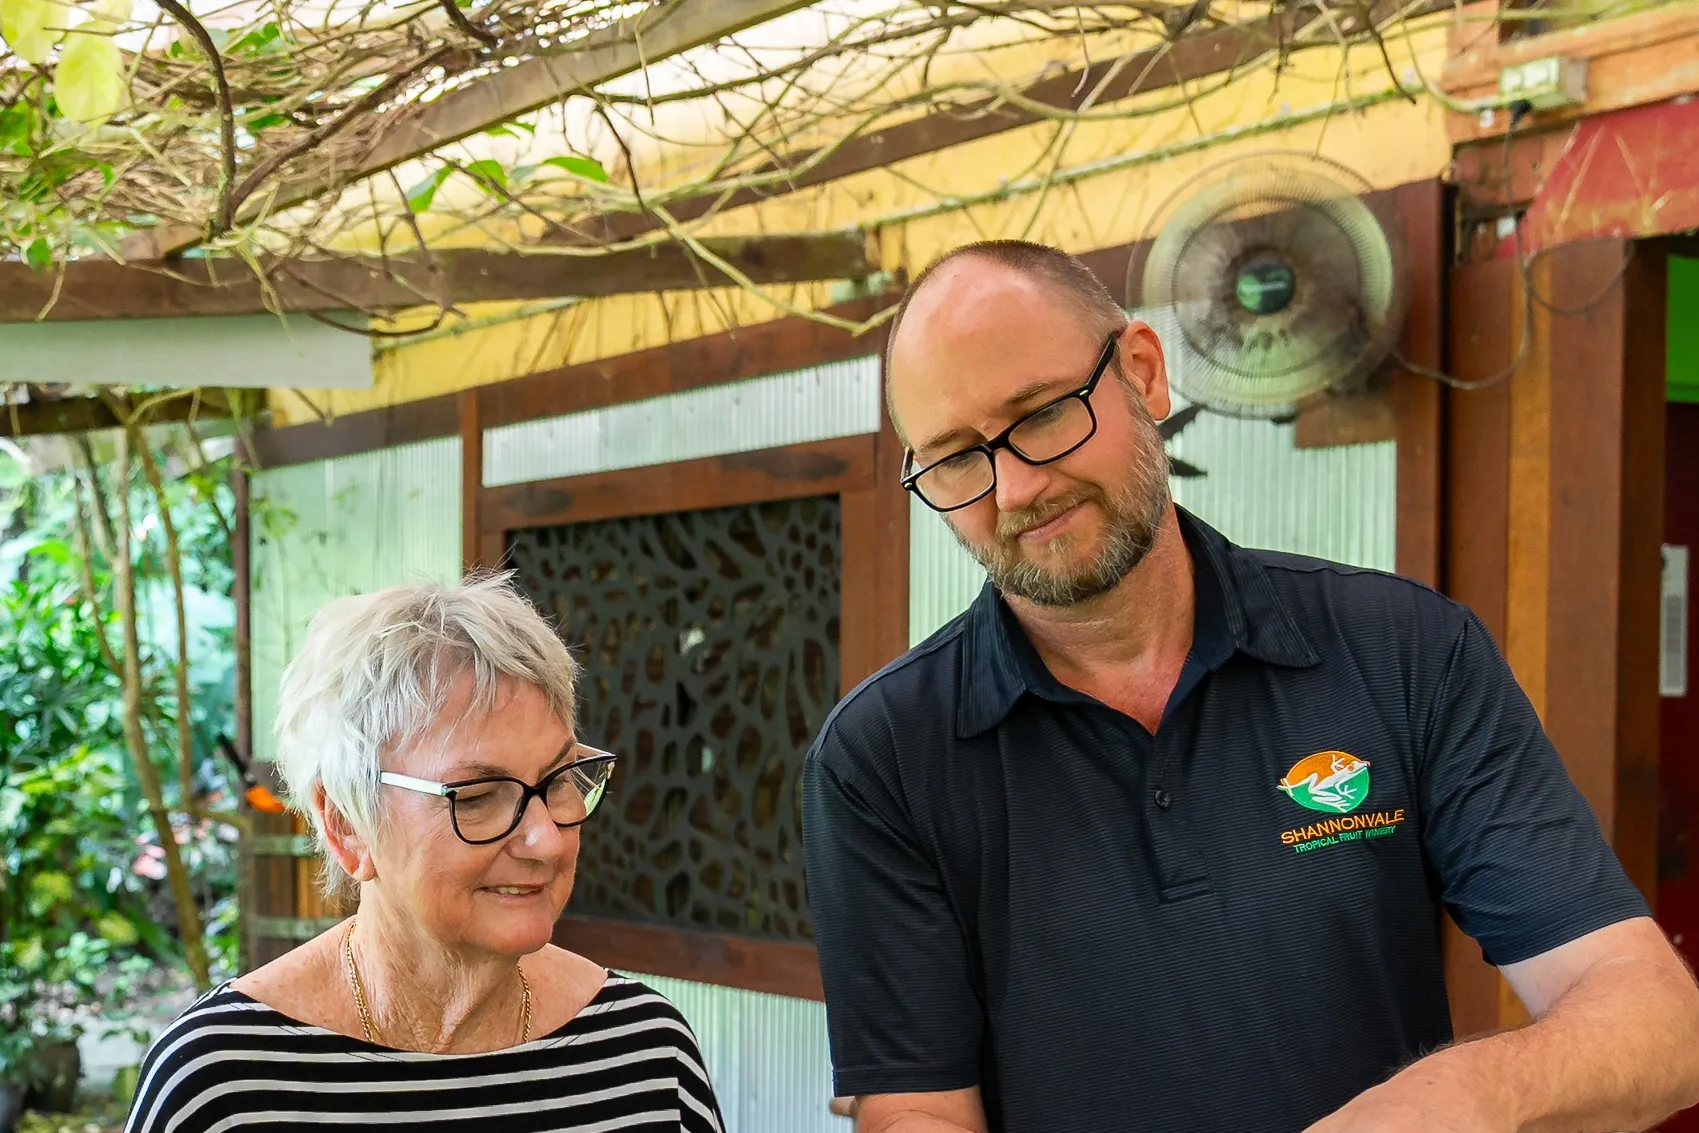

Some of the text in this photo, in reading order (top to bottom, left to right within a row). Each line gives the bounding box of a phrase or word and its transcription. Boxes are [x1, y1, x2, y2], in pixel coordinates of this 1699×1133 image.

[1281, 809, 1405, 844] SHANNONVALE
[1293, 826, 1396, 853] TROPICAL FRUIT WINERY
